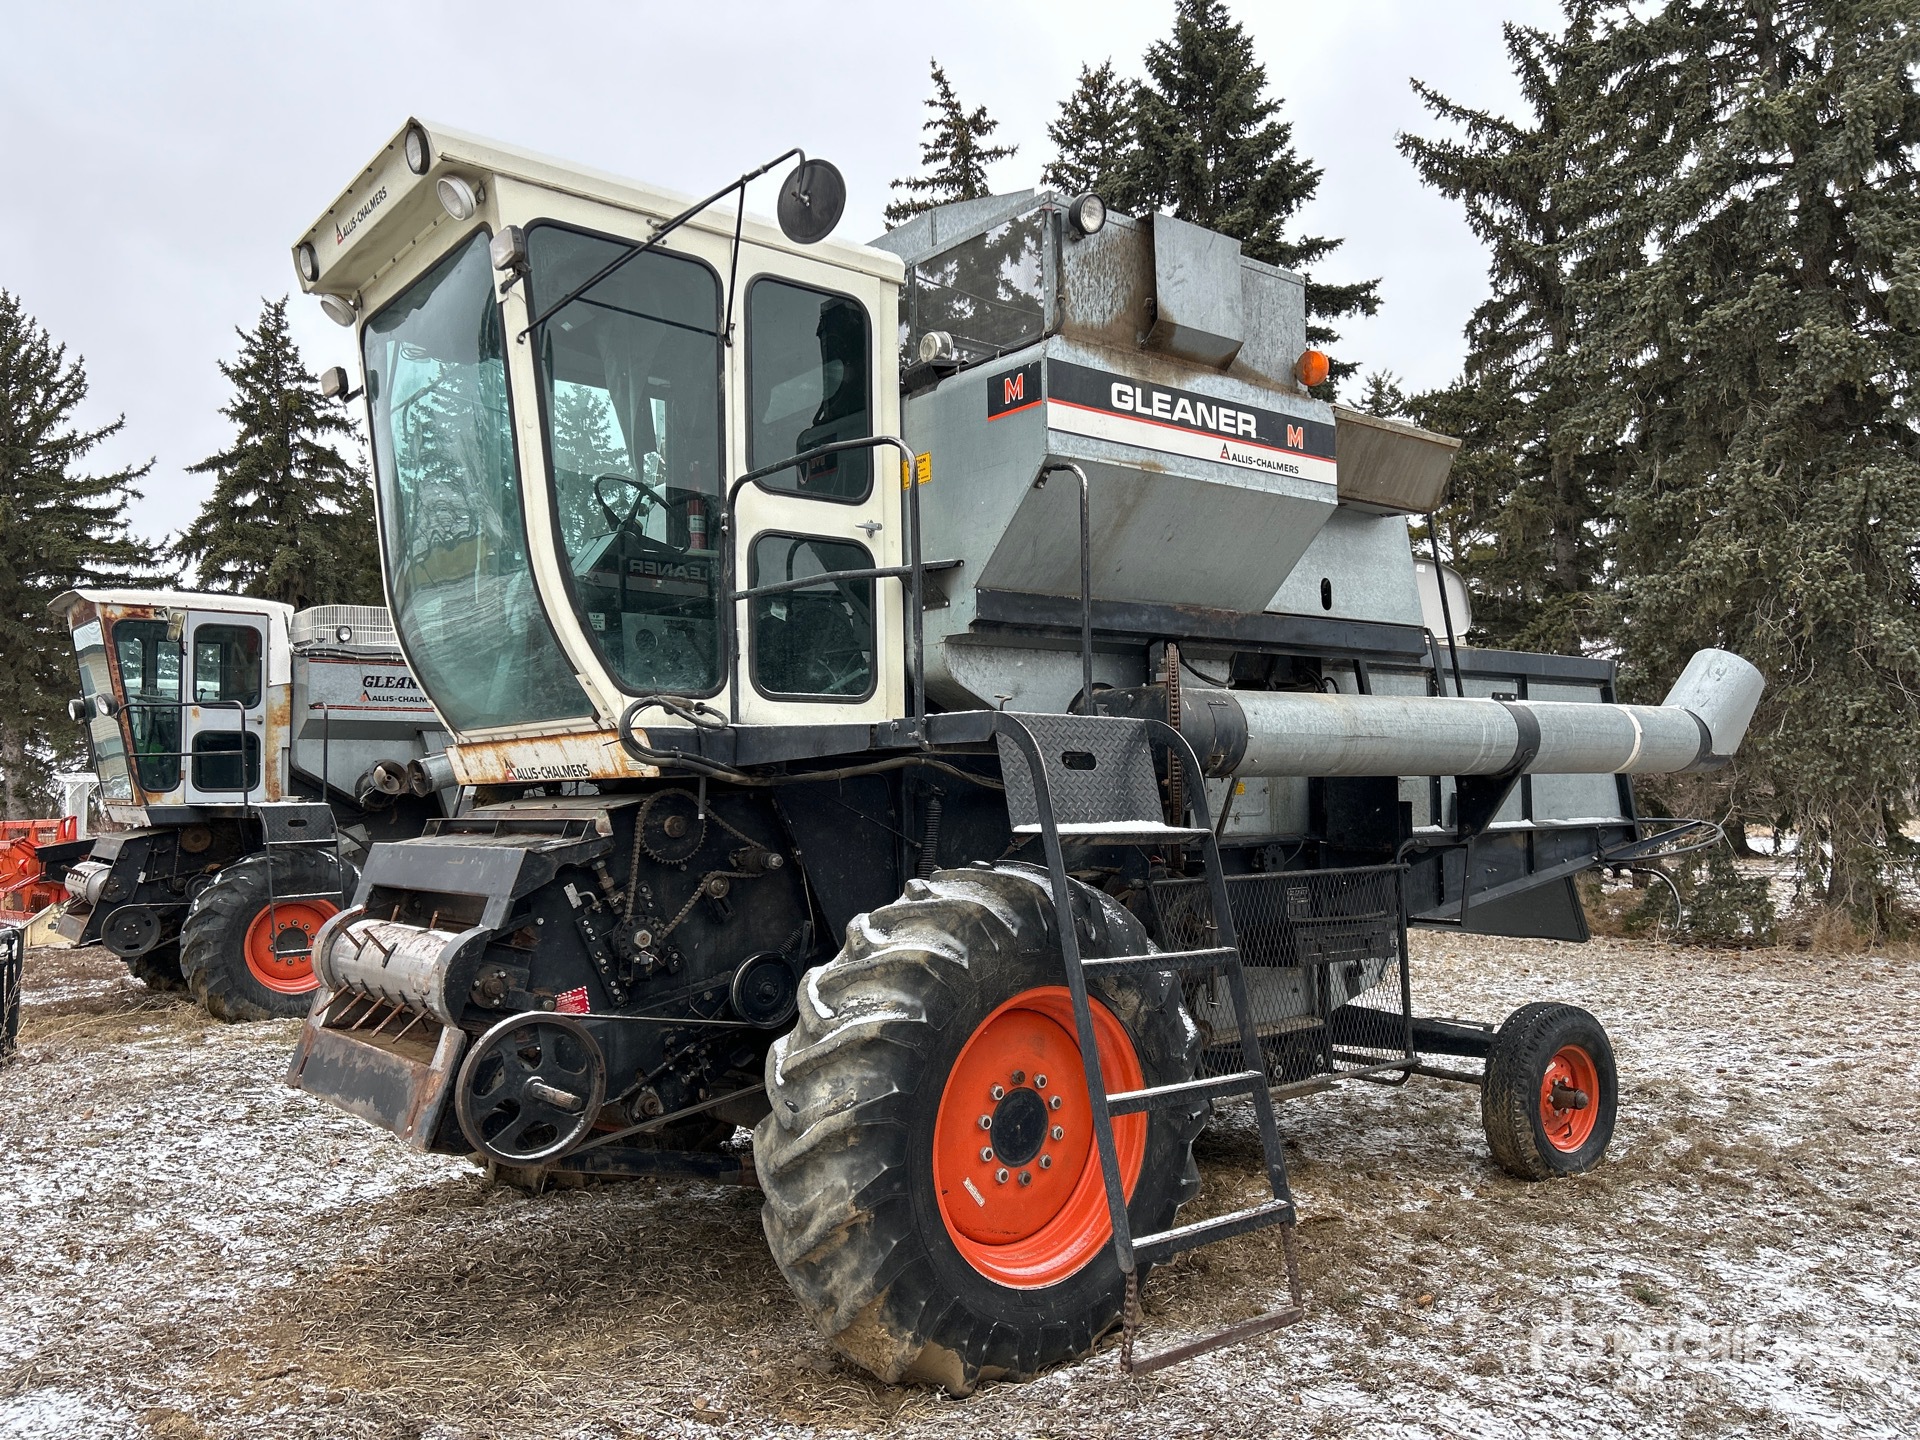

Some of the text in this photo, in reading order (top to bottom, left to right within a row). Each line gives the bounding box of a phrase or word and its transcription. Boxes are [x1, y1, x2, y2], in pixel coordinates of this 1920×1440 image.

[342, 186, 387, 239] ALLIS-CHALMERS
[1004, 372, 1024, 405] M
[1111, 382, 1304, 450] GLEANER M
[1231, 453, 1299, 475] ALLIS-CHALMERS
[362, 675, 419, 690] GLEAN
[371, 695, 428, 703] ALLIS-CHALM
[516, 763, 591, 780] ALLIS-CHALMERS
